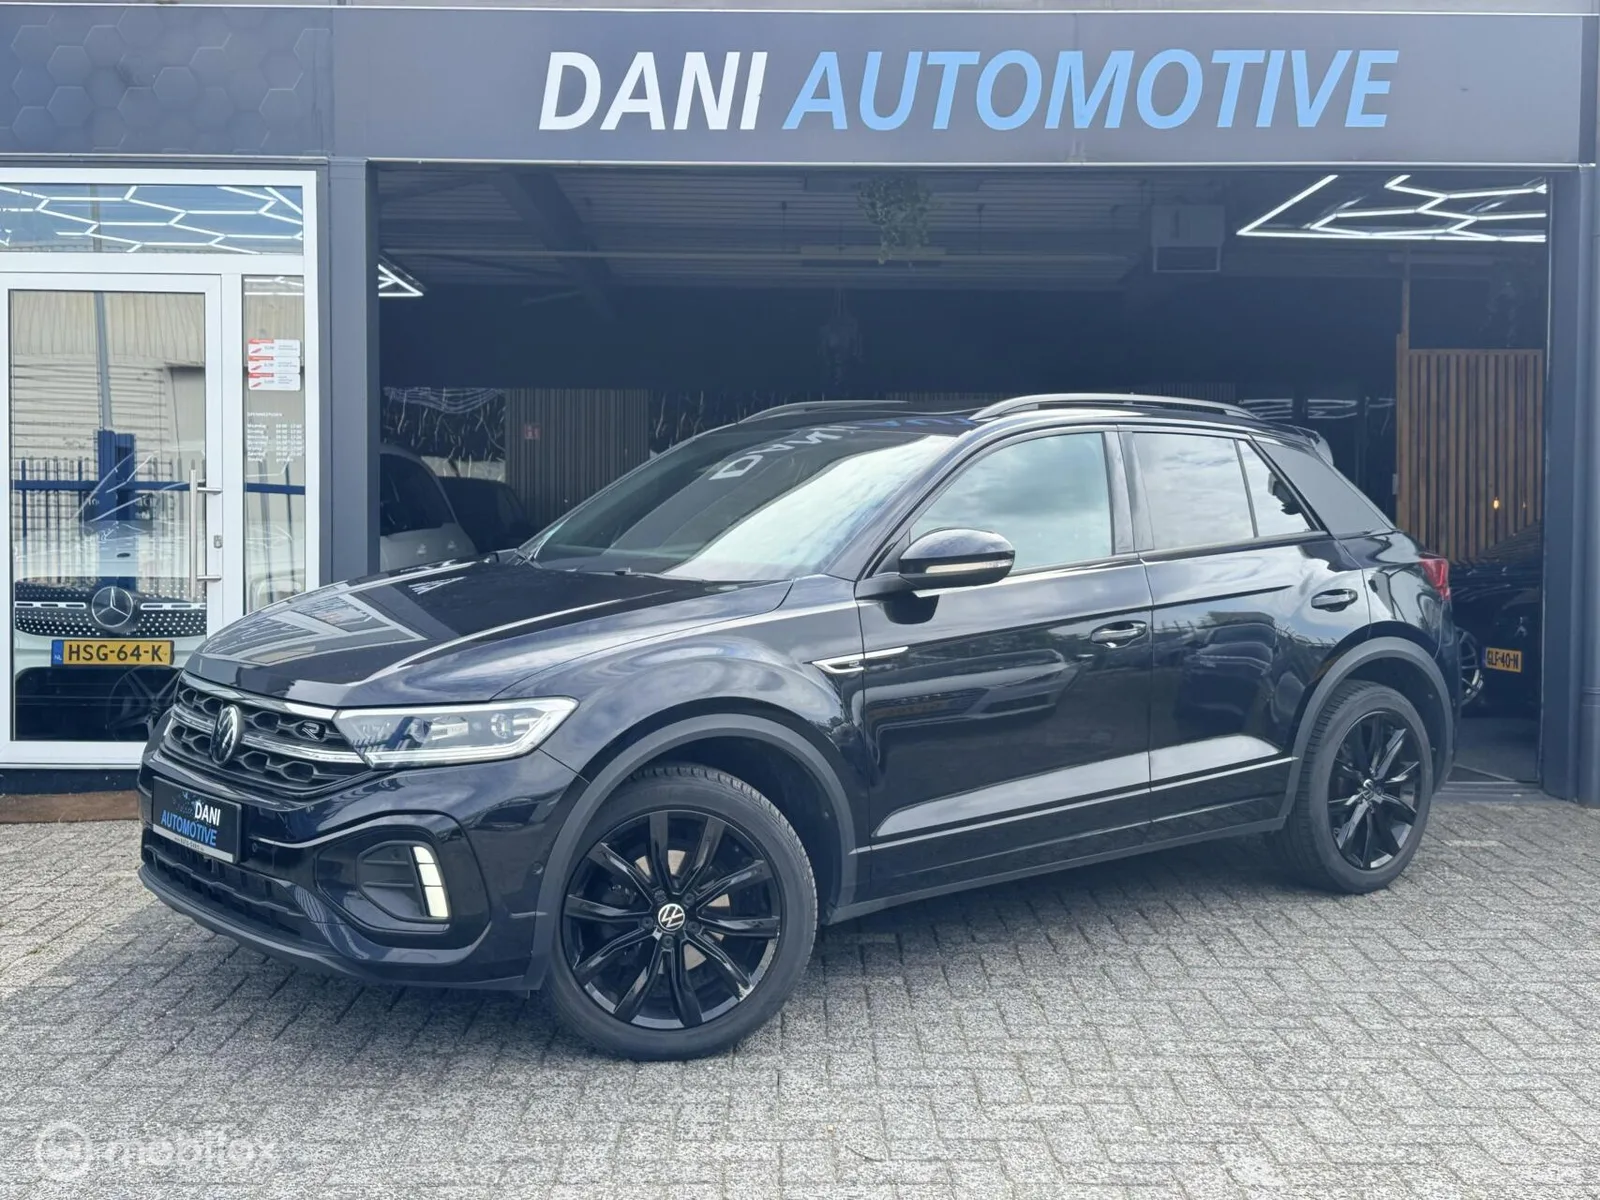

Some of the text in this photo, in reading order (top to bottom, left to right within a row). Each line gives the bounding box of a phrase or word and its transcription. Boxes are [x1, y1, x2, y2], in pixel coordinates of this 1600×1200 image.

[539, 48, 1399, 131] DANI AUTOMOTIVE
[68, 643, 164, 662] HSG-64-K
[160, 809, 218, 847] AUTOMOTIVE
[194, 801, 221, 826] DANI
